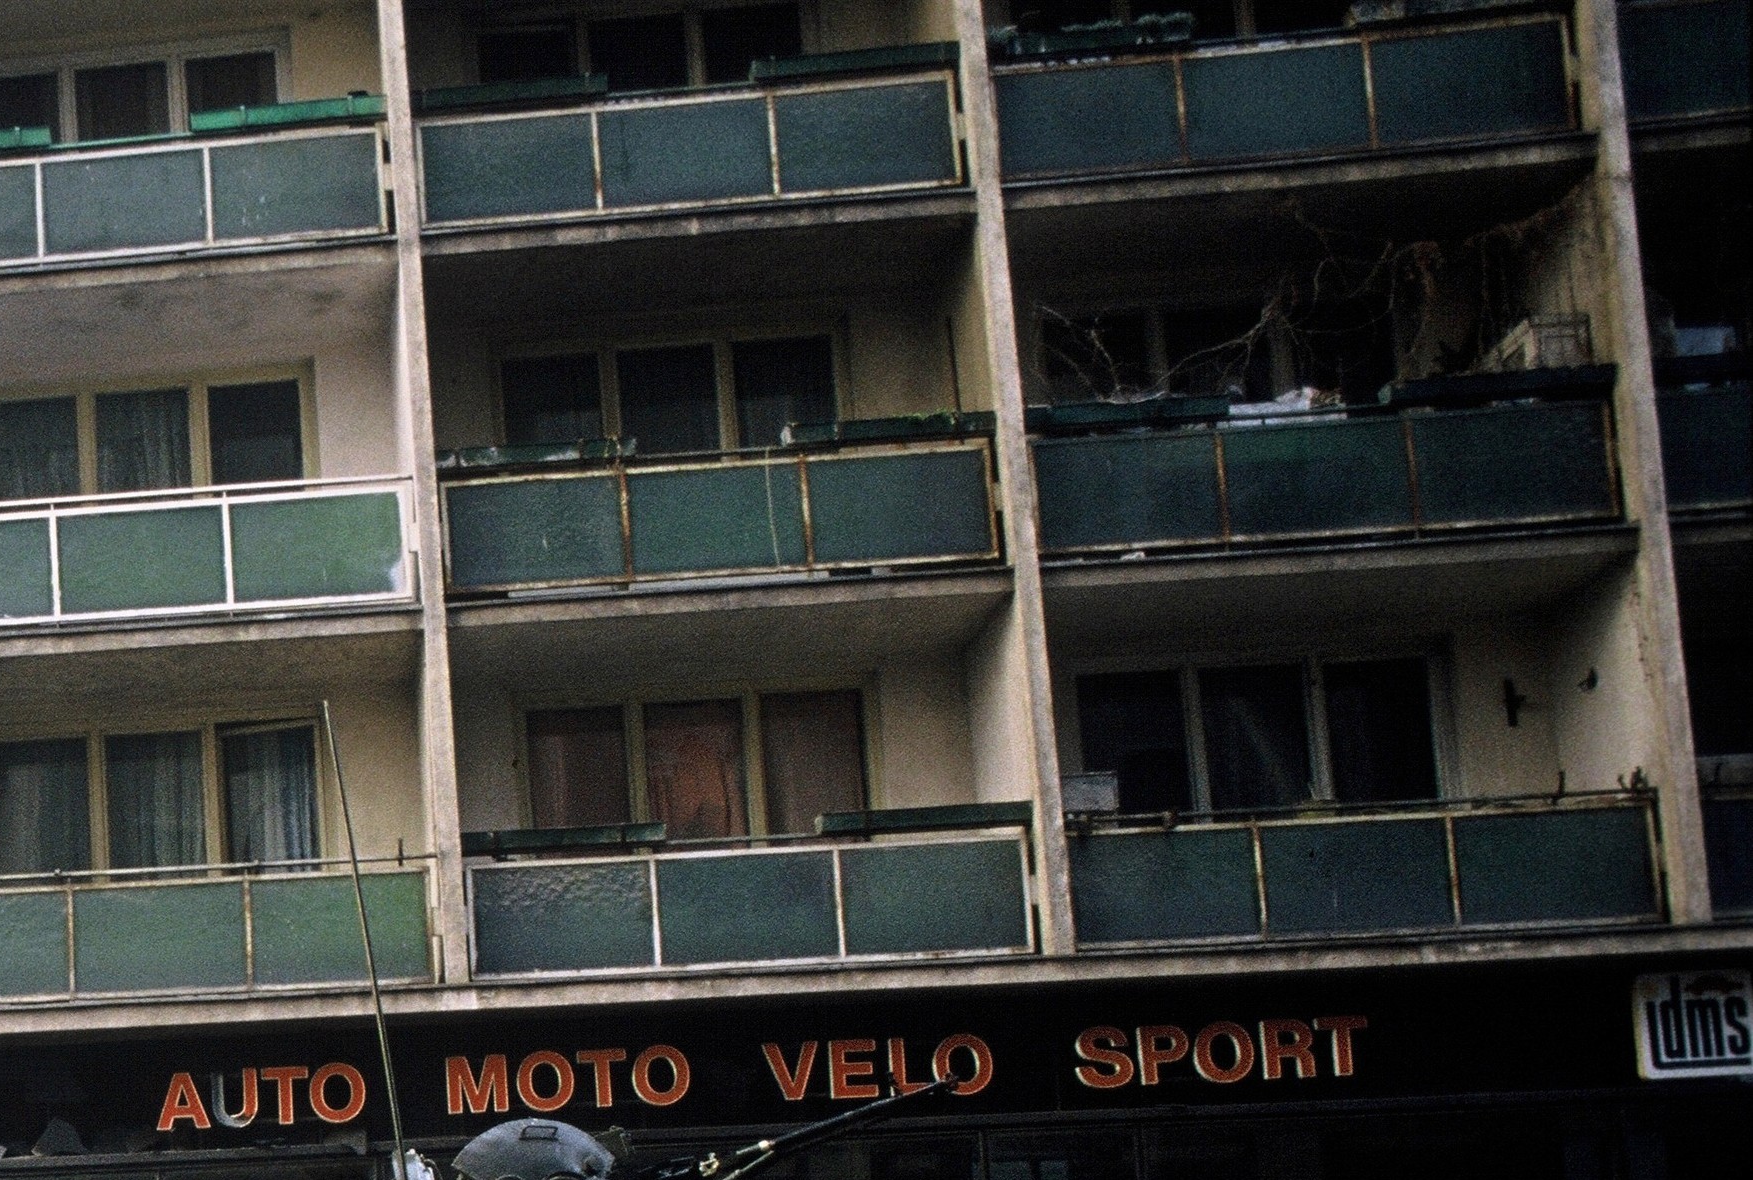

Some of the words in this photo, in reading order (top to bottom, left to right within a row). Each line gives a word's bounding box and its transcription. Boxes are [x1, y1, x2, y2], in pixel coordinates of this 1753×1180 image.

[156, 1062, 366, 1132] AUTO
[446, 1044, 691, 1115] MOTO
[762, 1033, 993, 1101] VELO
[1075, 1014, 1368, 1088] SPORT
